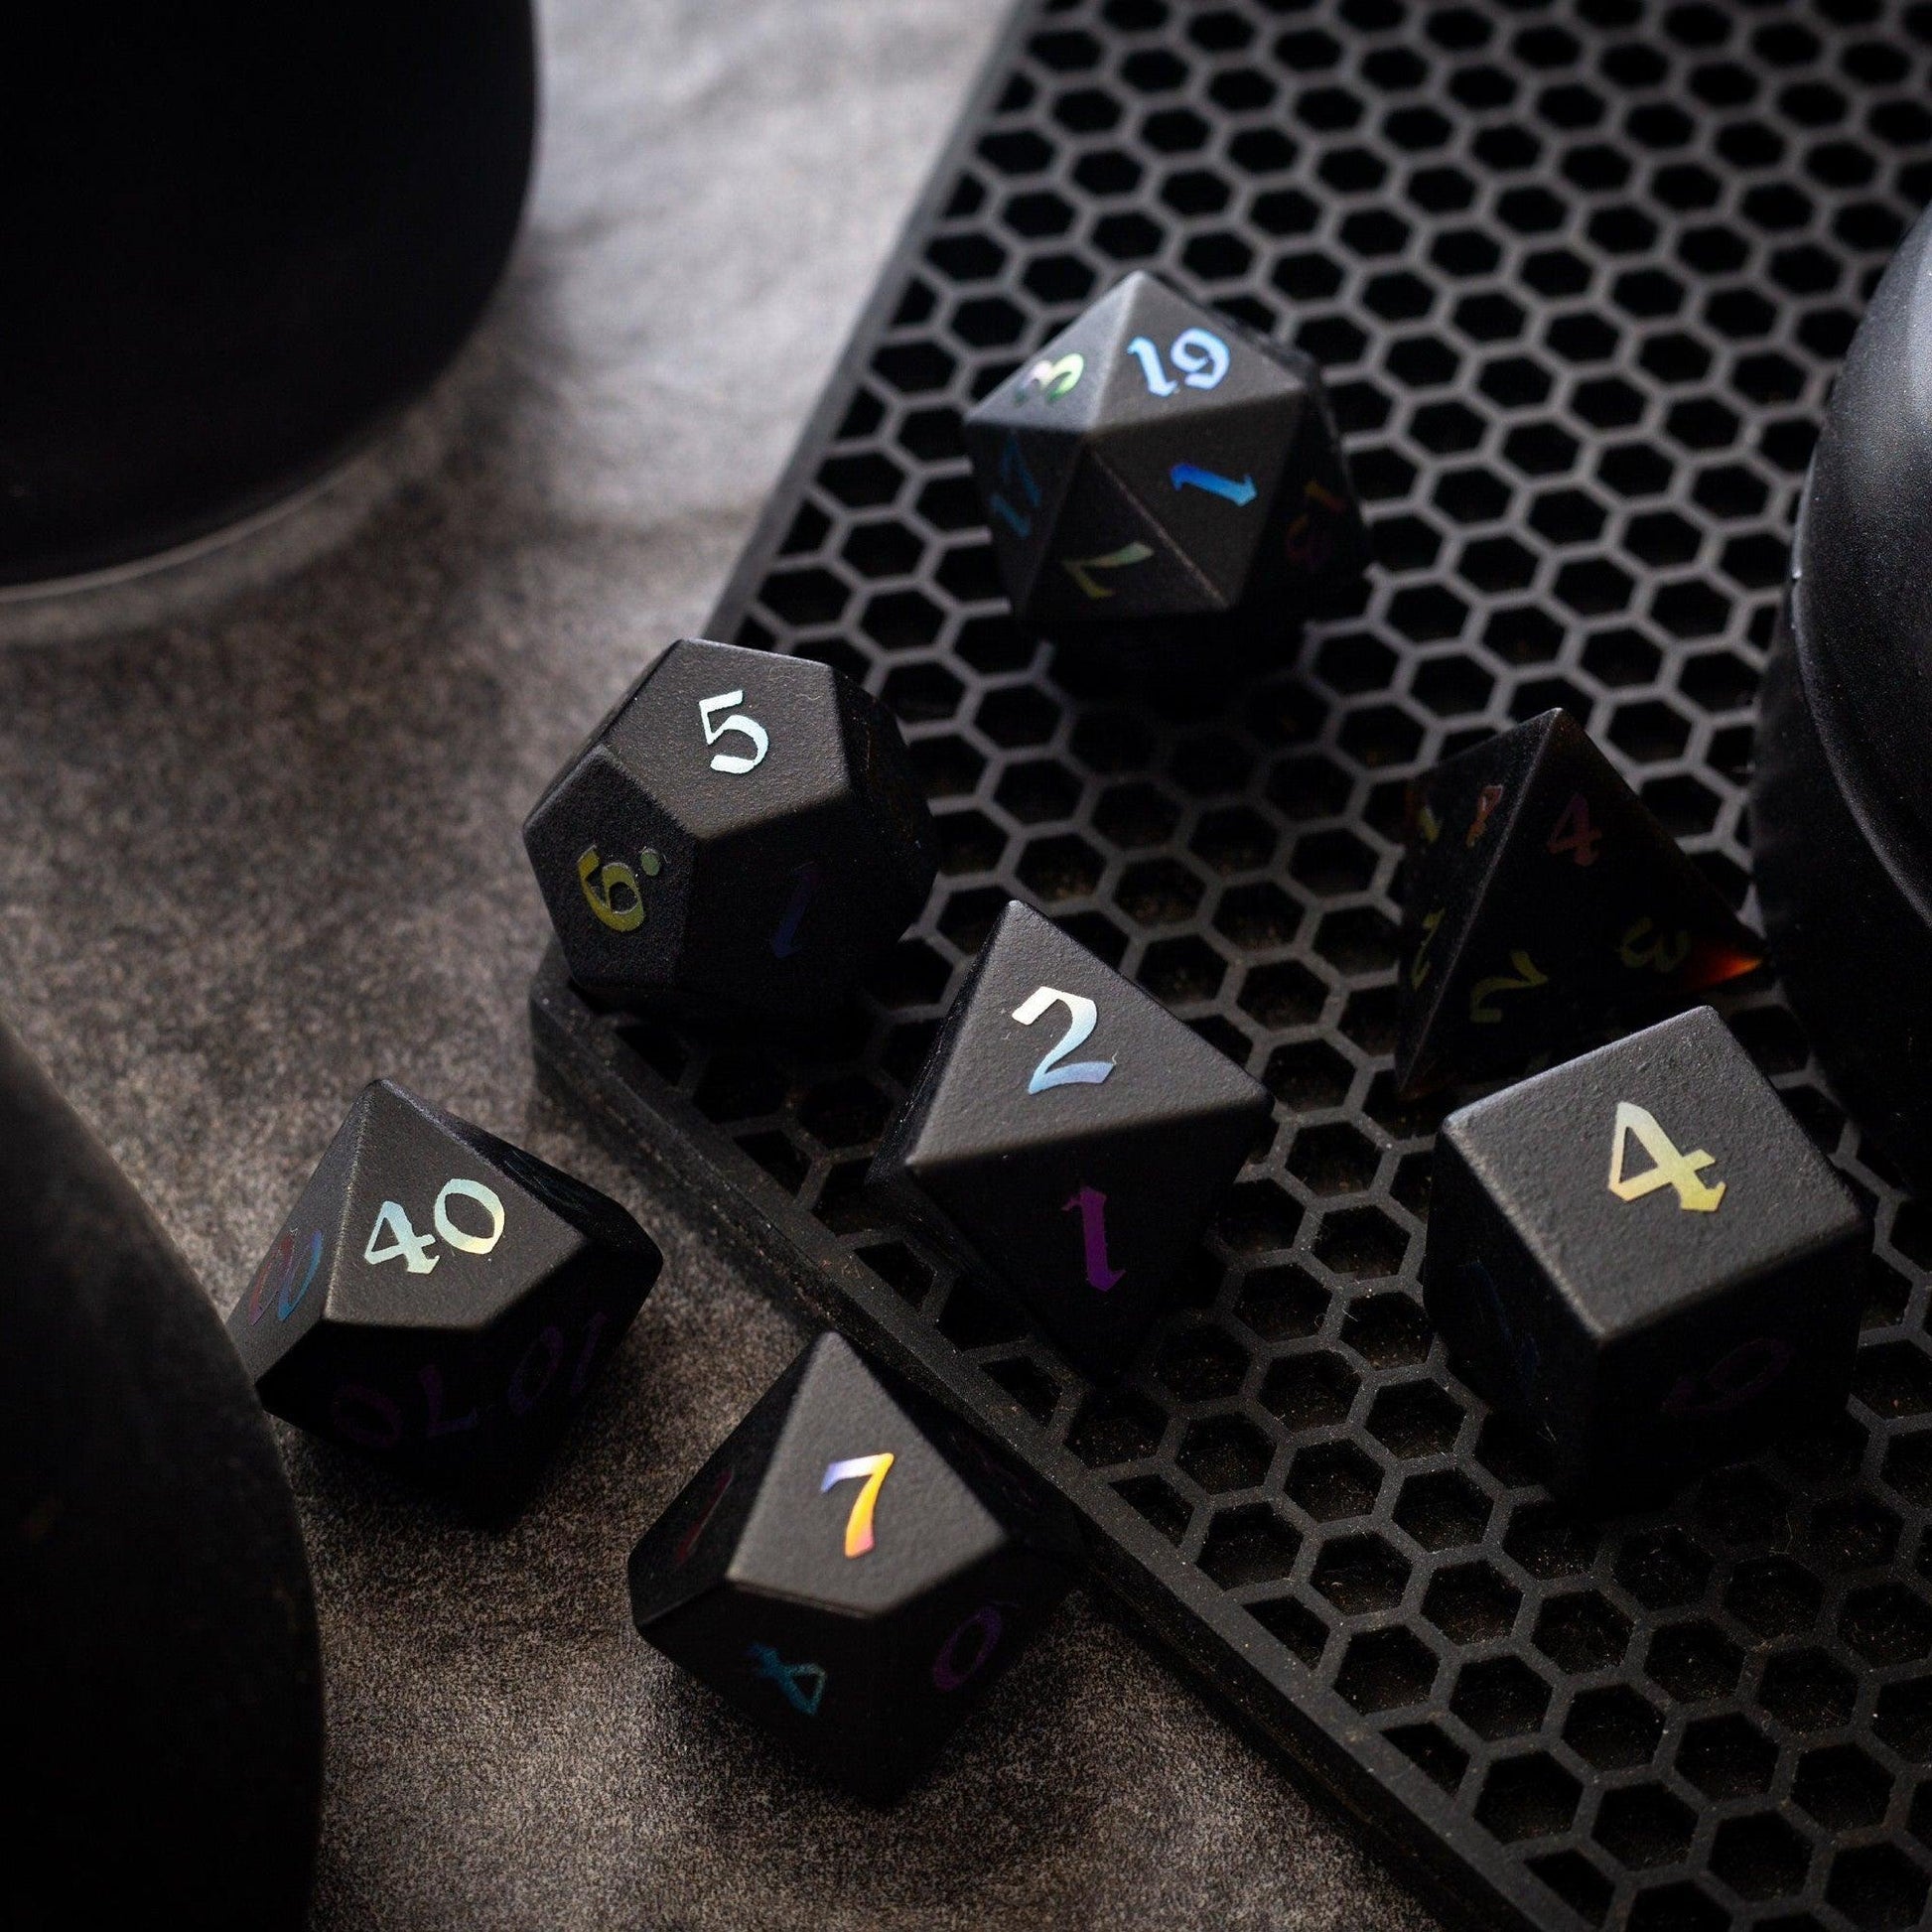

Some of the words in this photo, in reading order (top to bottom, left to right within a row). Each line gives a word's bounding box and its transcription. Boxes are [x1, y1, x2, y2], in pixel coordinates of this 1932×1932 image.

[1127, 327, 1231, 397] 19
[1171, 463, 1259, 507] 1
[1060, 541, 1155, 600] 7
[698, 689, 769, 774] 5
[1545, 794, 1603, 868] 4
[1469, 948, 1550, 1026] 2
[1011, 985, 1115, 1095] 2
[1607, 1099, 1727, 1212] 4
[363, 1177, 505, 1275] 40
[1060, 1183, 1128, 1292] 1
[820, 1452, 895, 1560] 7
[748, 1641, 828, 1718] 4
